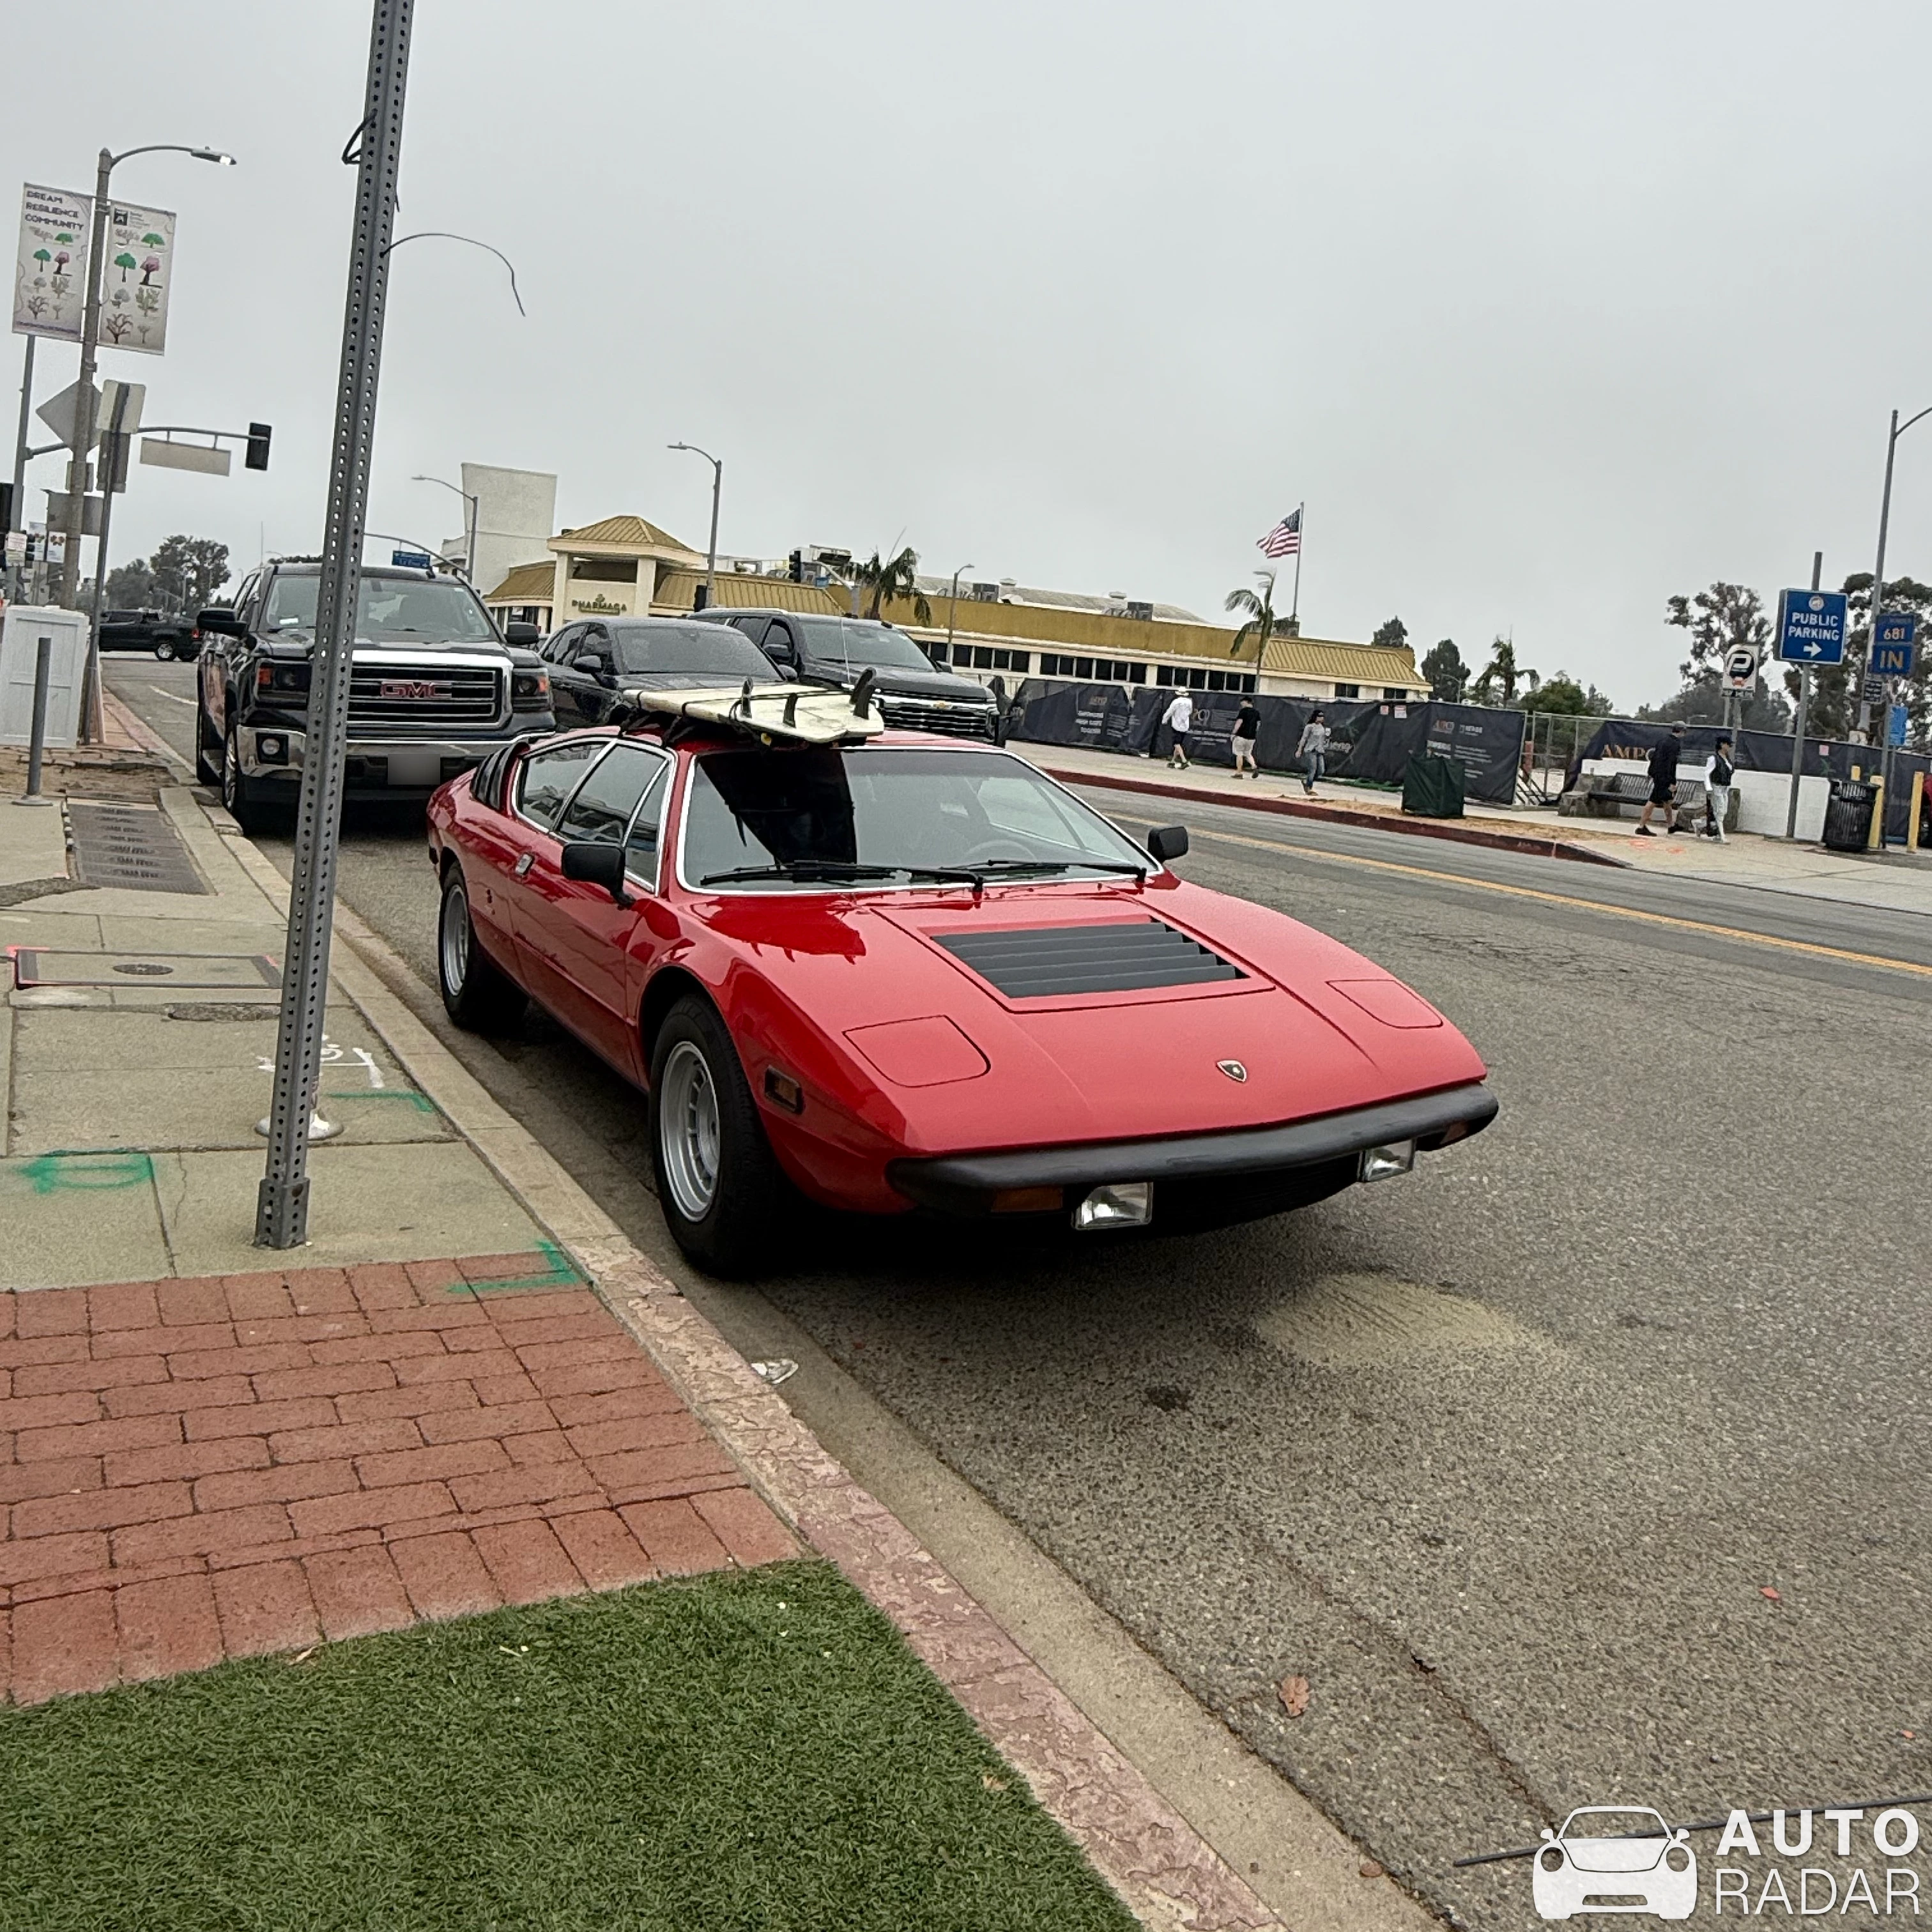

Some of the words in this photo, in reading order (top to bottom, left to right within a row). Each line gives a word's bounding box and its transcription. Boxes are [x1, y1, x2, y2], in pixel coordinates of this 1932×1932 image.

[27, 191, 63, 204] DREAM
[26, 201, 79, 218] RESILIENCE
[24, 213, 84, 231] COMMUNITY
[1791, 611, 1839, 627] PUBLIC
[1788, 625, 1840, 641] PARKING
[1883, 627, 1905, 640] 681
[1880, 650, 1904, 669] IN
[380, 681, 452, 698] GMC
